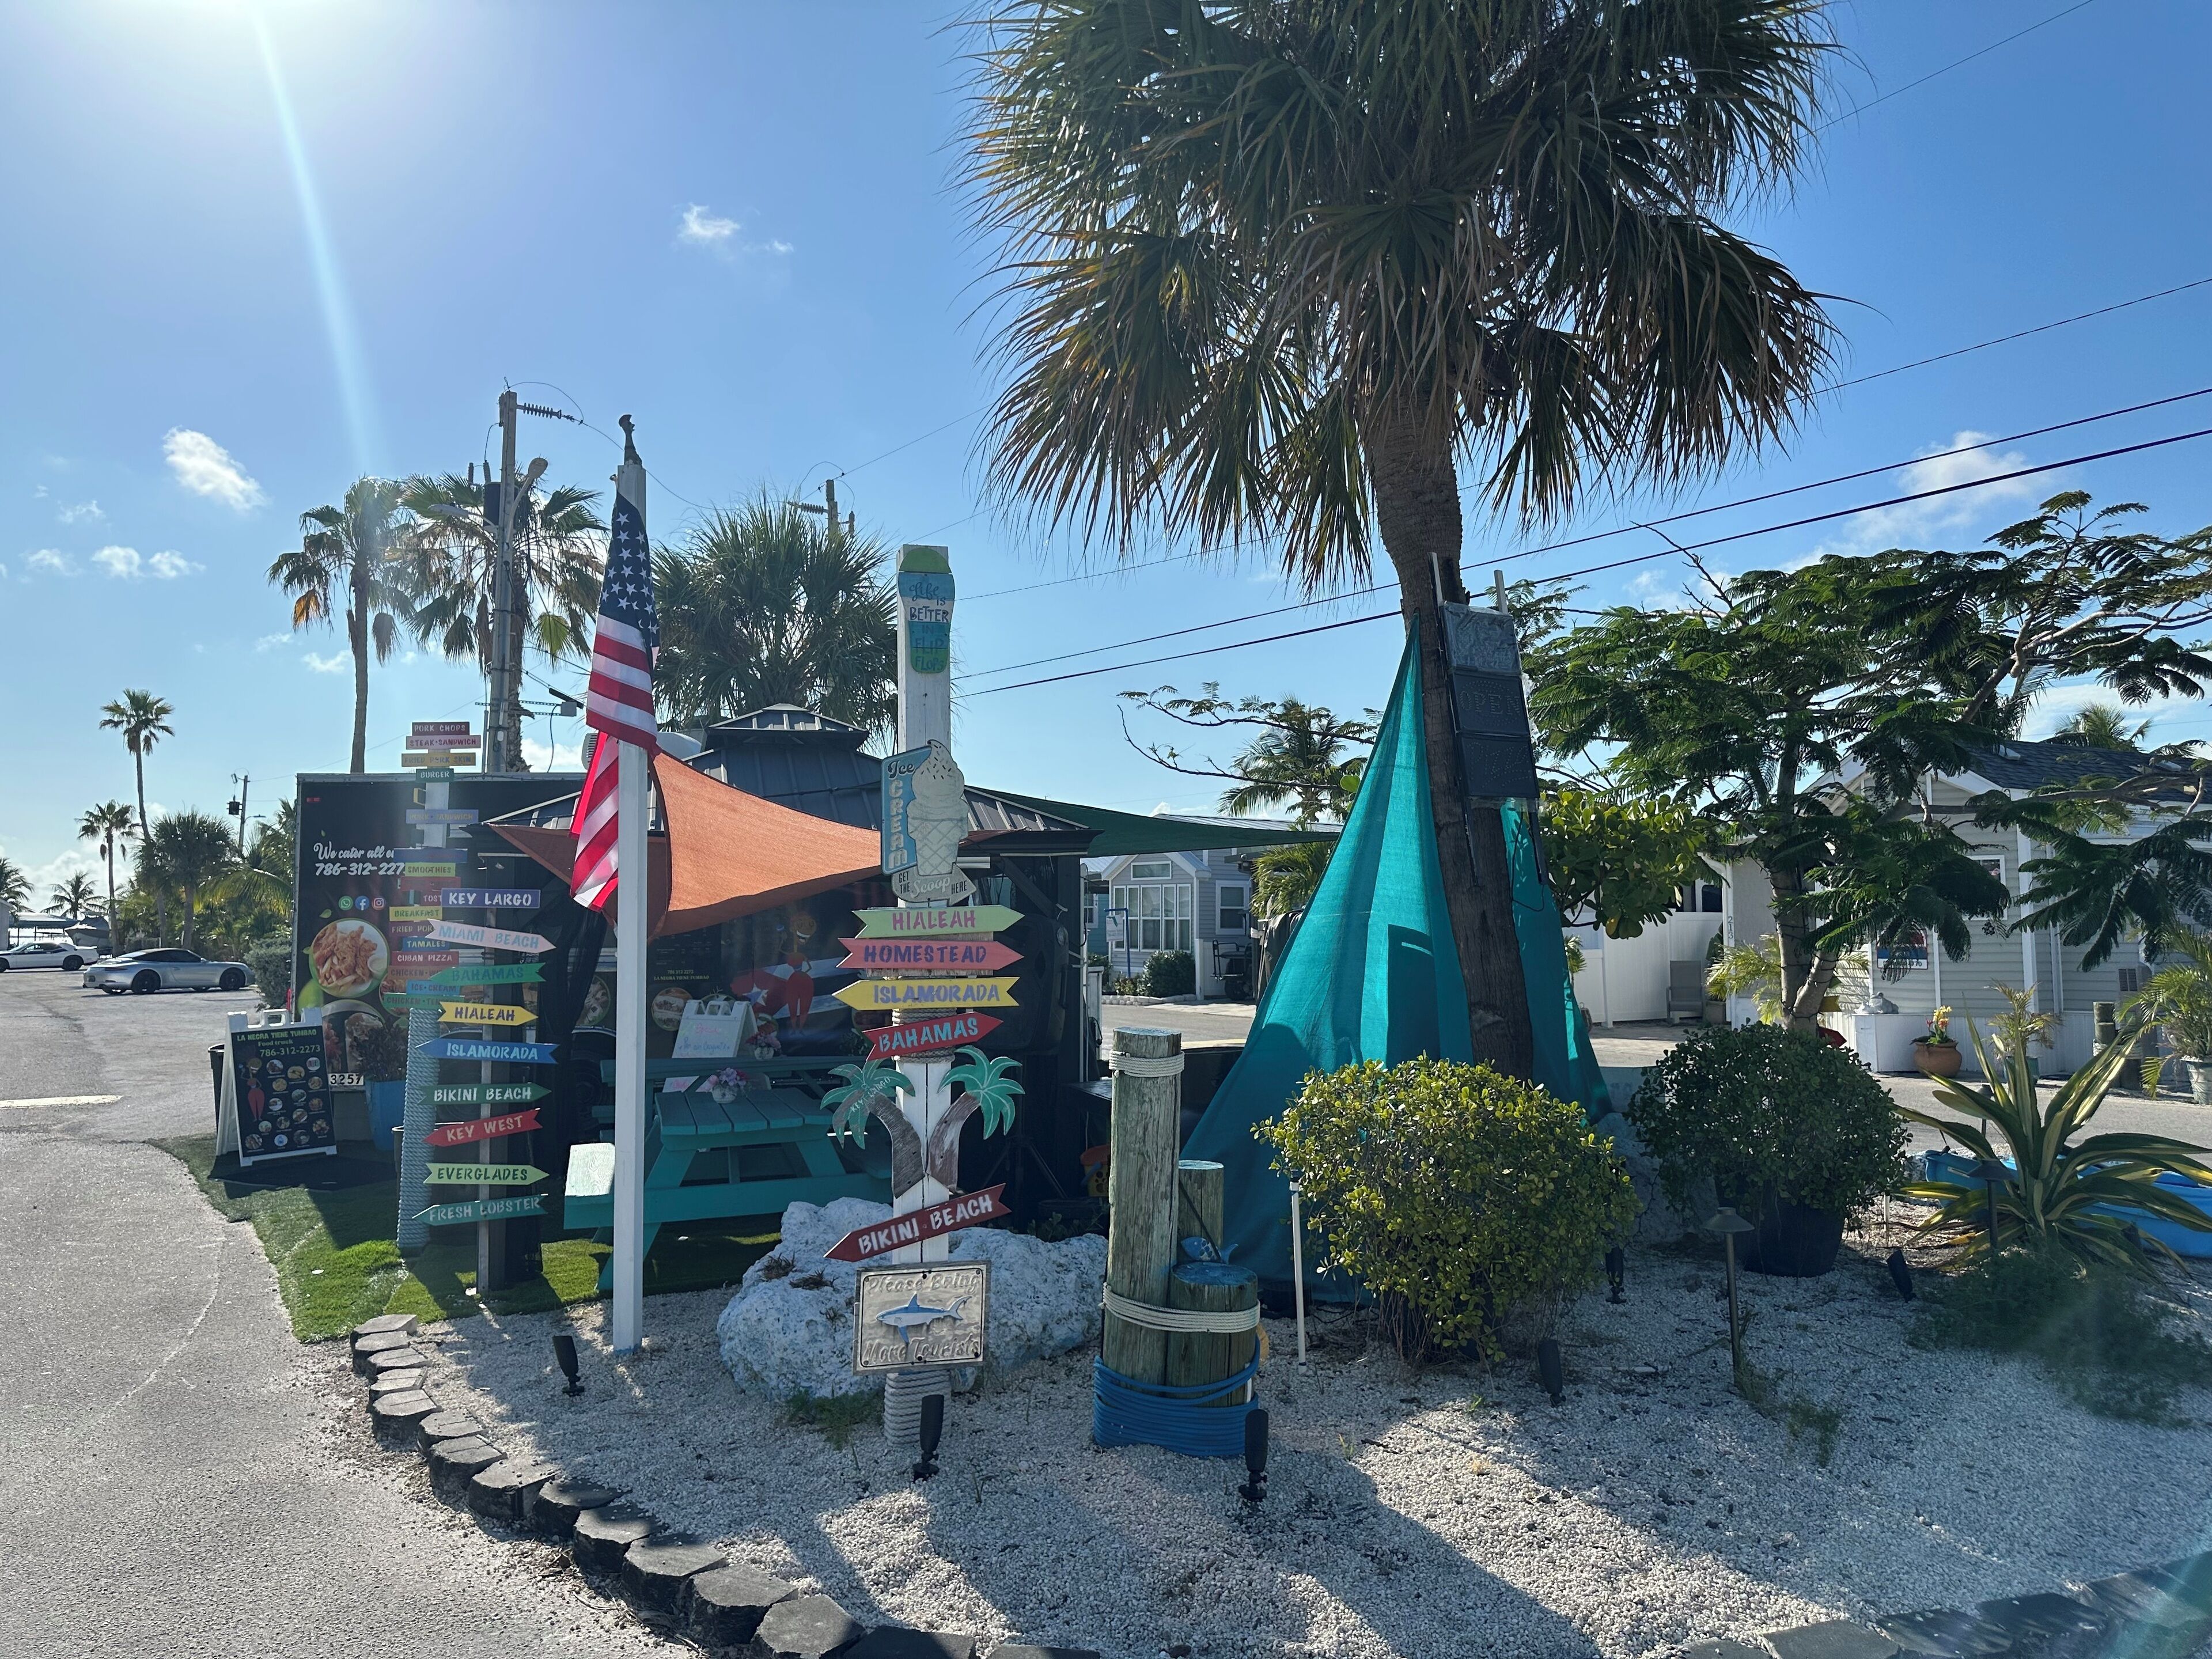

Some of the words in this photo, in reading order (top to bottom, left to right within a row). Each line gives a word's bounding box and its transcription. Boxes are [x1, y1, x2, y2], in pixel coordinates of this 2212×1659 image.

[909, 582, 940, 601] Life
[910, 605, 949, 622] BETTER
[922, 625, 934, 634] IN
[915, 637, 944, 654] FLIP
[1459, 691, 1521, 715] OPEN
[887, 760, 916, 779] Ice
[888, 779, 907, 868] CREAM
[313, 840, 338, 860] We
[338, 847, 365, 858] cater
[366, 846, 385, 858] all
[315, 862, 406, 876] 786-312-227
[899, 871, 909, 883] GET
[900, 882, 910, 894] THE
[910, 877, 950, 898] Scoop
[951, 880, 967, 895] HERE
[449, 892, 477, 905] KEY
[484, 893, 532, 906] LARGO
[395, 909, 440, 918] BREAKFAST
[892, 910, 976, 931] HIALEAH
[438, 925, 485, 942] MIAMI
[494, 932, 539, 949] BEACH
[864, 945, 987, 963] HOMESTEAD
[452, 967, 524, 982] BAHAMAS
[429, 984, 456, 992] CREAM
[873, 984, 1000, 1004] ISLAMORADA
[454, 1007, 516, 1021] HIALEAH
[290, 1029, 317, 1037] TUMBAO
[878, 1017, 979, 1052] BAHAMAS
[260, 1045, 320, 1058] 786-312-2273
[446, 1043, 539, 1060] ISLAMORADA
[330, 1074, 362, 1085] 3257
[434, 1088, 478, 1102] BIKINI
[486, 1087, 531, 1100] BEACH
[446, 1124, 474, 1142] KEY
[483, 1115, 523, 1134] WEST
[437, 1168, 528, 1181] EVERGLADES
[429, 1205, 472, 1221] FRESH
[480, 1198, 540, 1216] LOBSTER
[858, 1217, 920, 1255] BIKINI
[930, 1194, 993, 1230] BEACH
[866, 1276, 925, 1296] Please
[930, 1272, 980, 1295] Bring
[862, 1339, 908, 1364] More
[909, 1333, 980, 1360] Tourists
